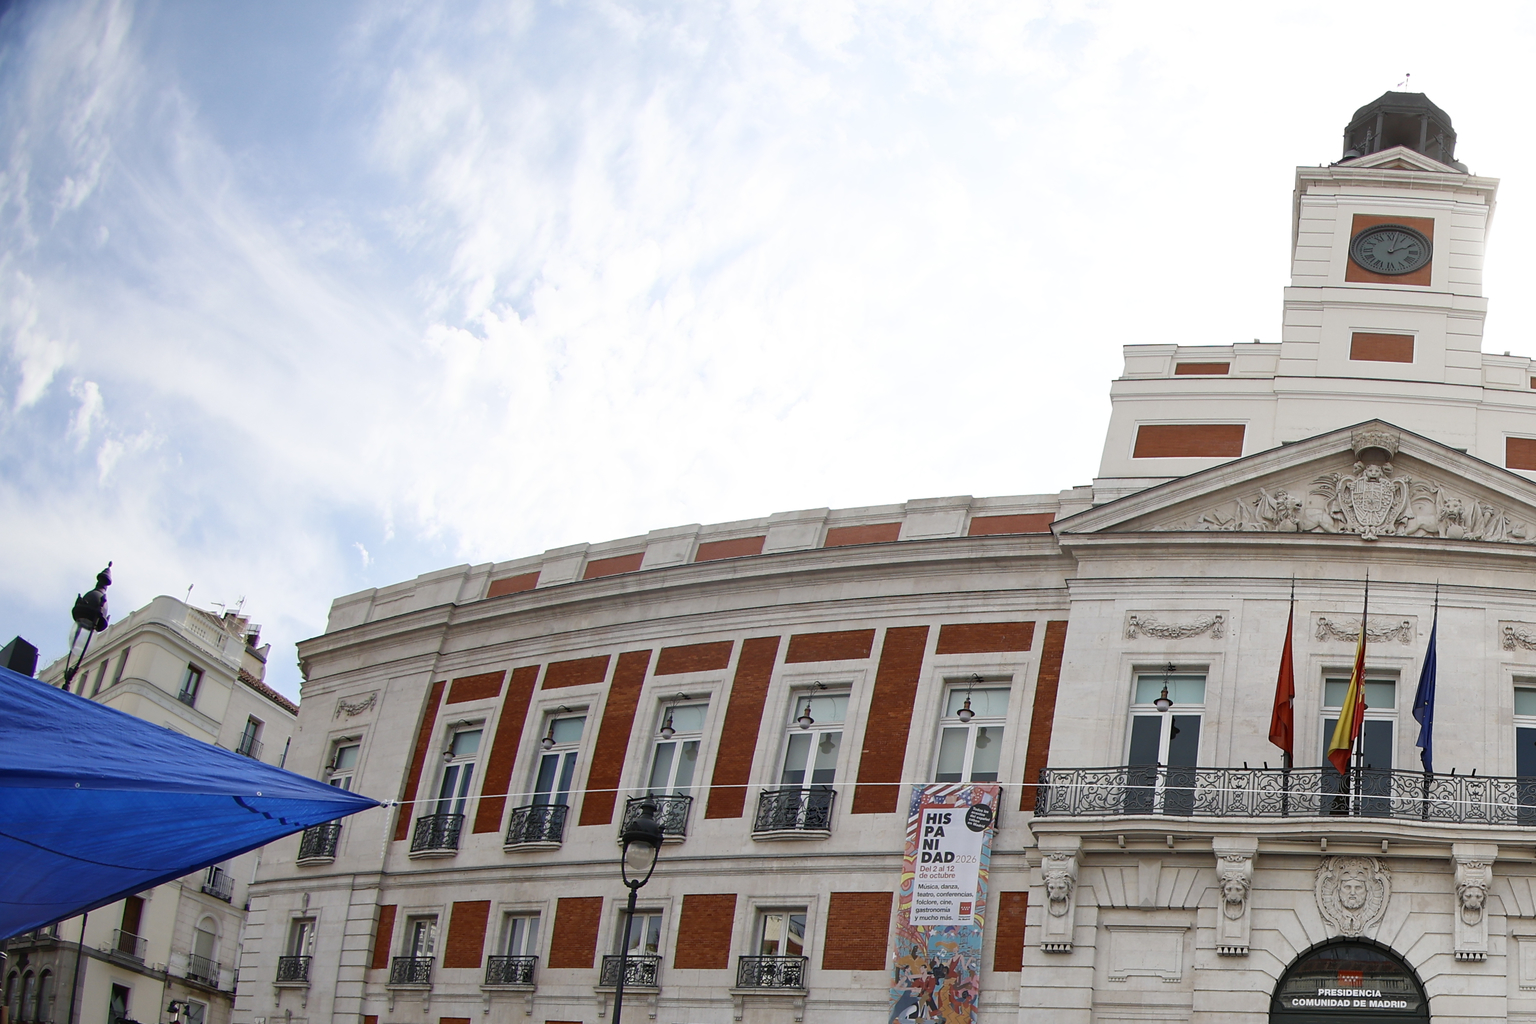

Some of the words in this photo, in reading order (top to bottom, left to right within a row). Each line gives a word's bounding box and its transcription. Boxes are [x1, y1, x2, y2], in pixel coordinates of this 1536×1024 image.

[926, 812, 953, 825] HIS
[924, 825, 945, 838] PA
[922, 838, 940, 851] NI
[921, 851, 955, 864] DAD
[955, 854, 977, 864] 2026
[1318, 988, 1382, 998] PRESIDENCIA
[1292, 998, 1350, 1007] COMUNIDAD
[1353, 999, 1366, 1008] DE
[1369, 1000, 1407, 1008] MADRID
